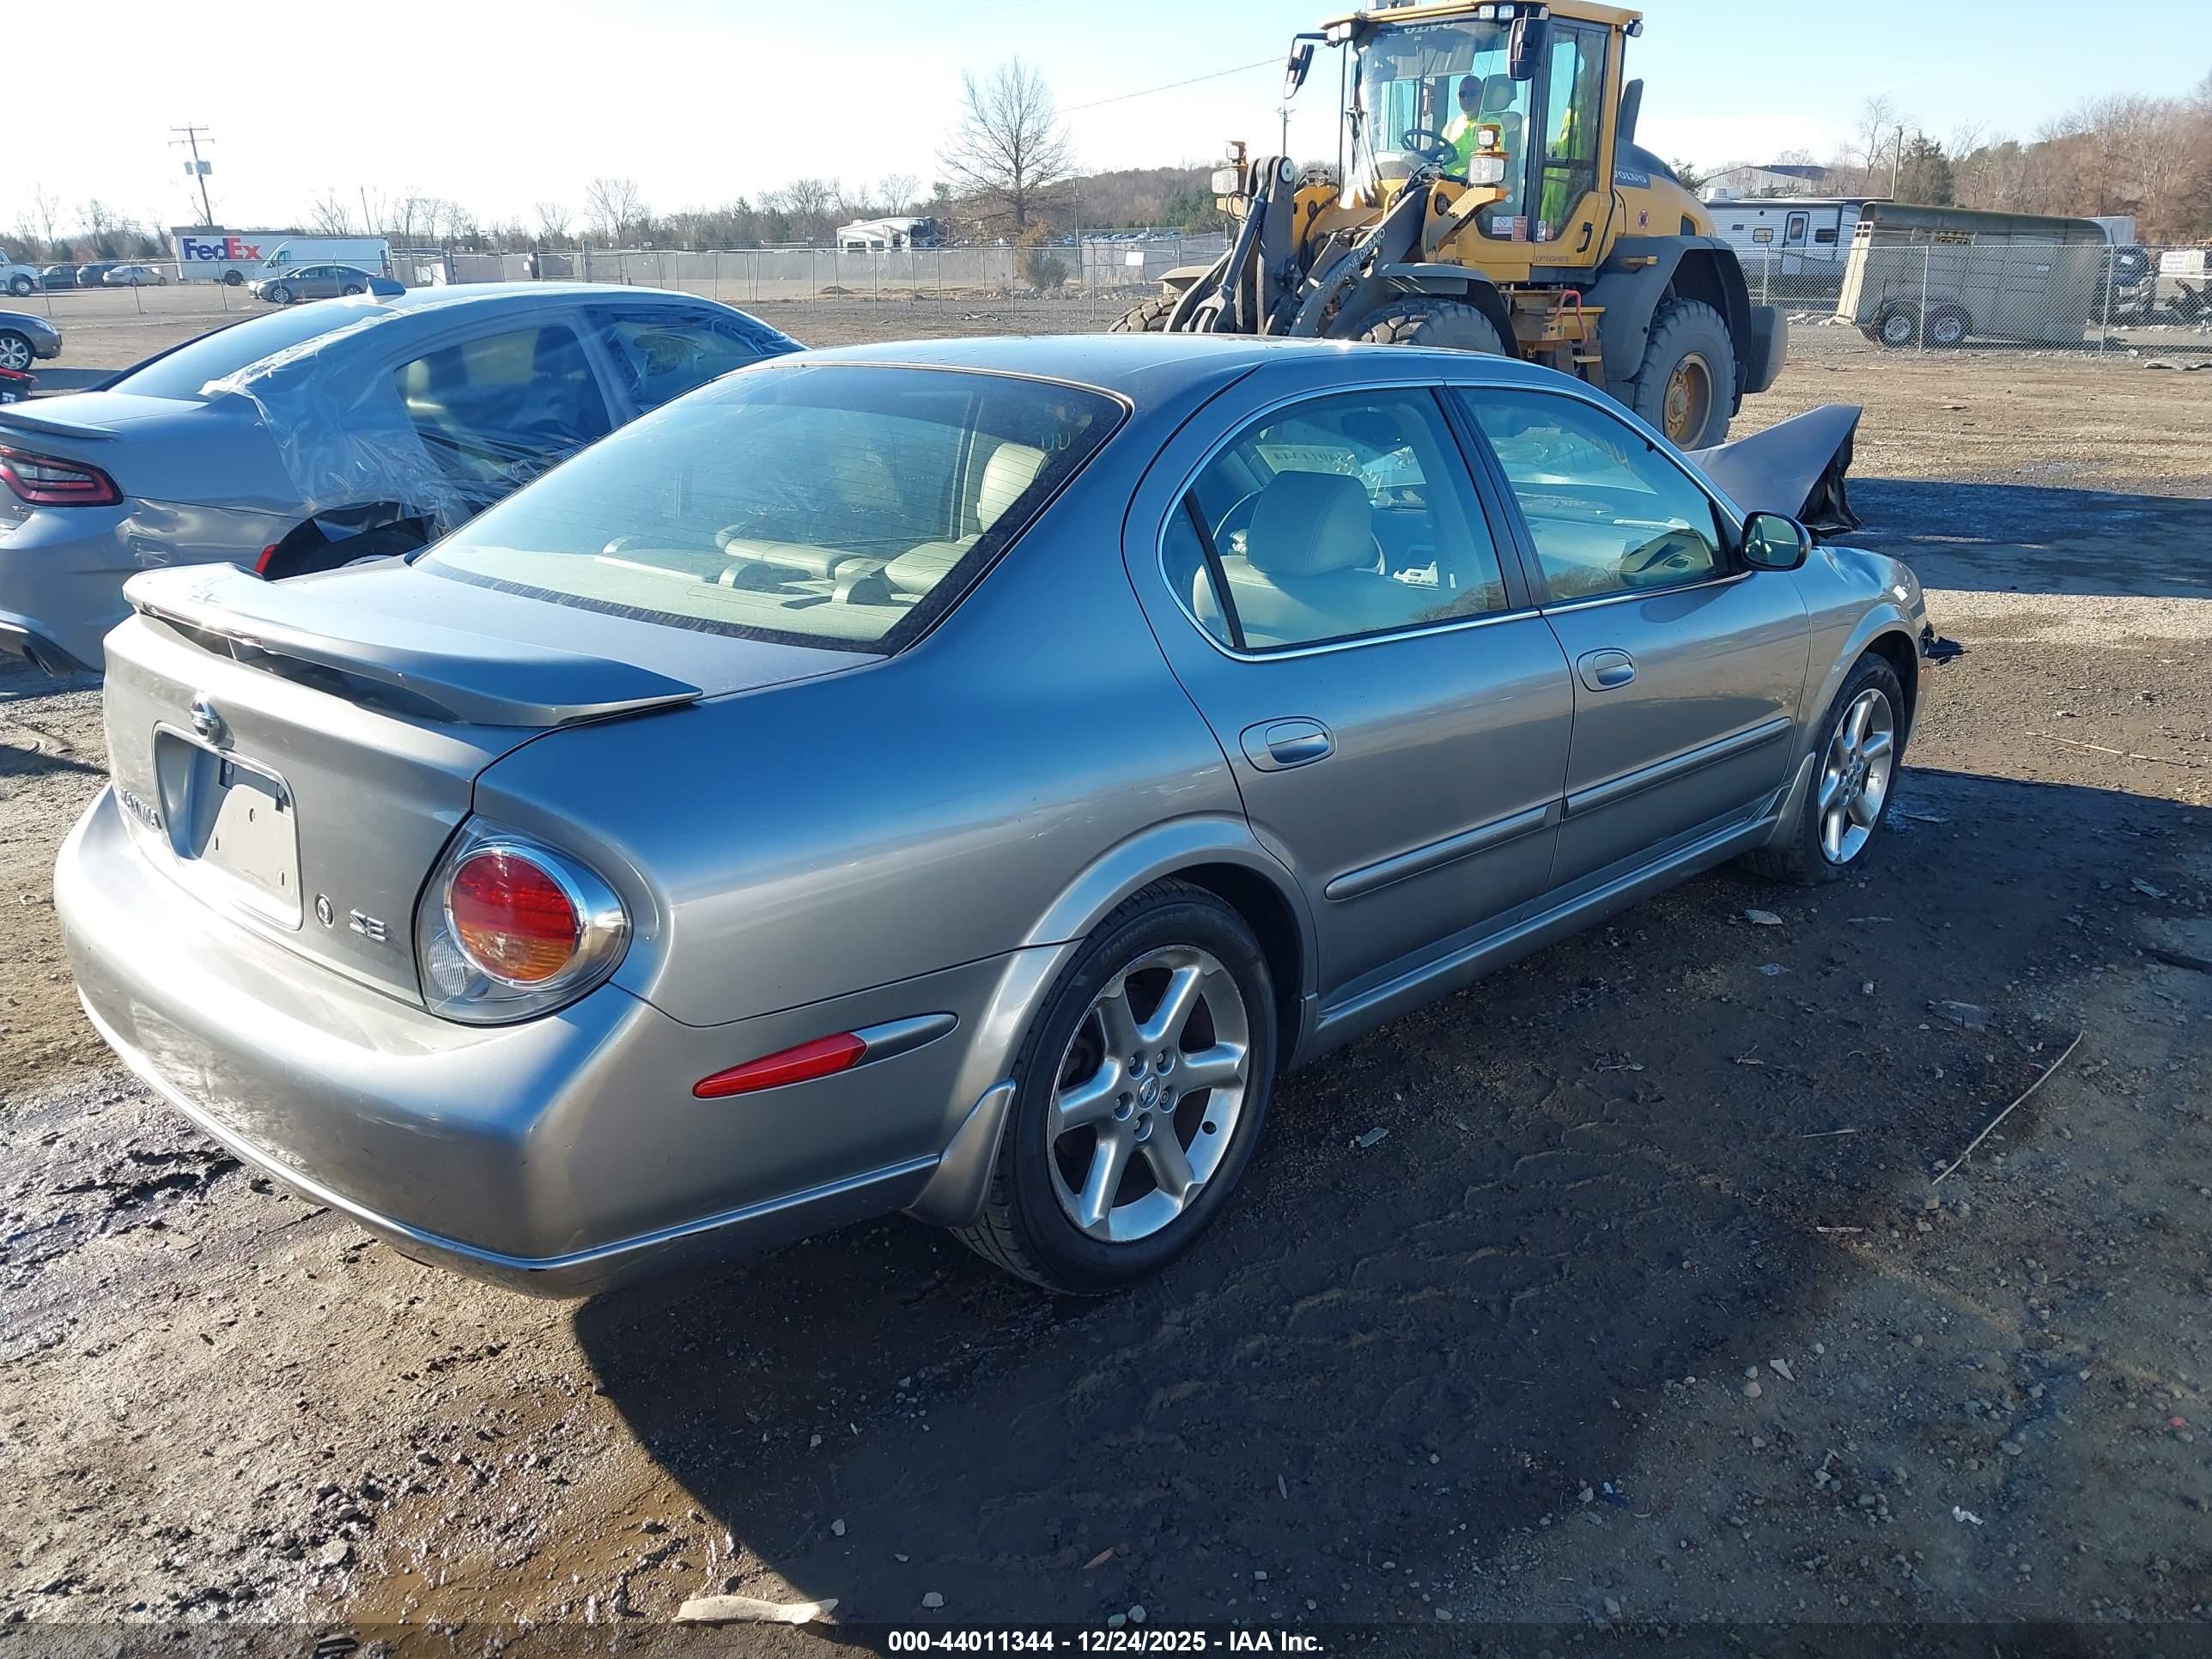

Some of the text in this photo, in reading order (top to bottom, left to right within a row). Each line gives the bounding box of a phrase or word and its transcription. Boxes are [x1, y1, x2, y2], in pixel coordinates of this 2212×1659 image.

[182, 238, 263, 261] FedEx
[1331, 255, 1359, 287] CAMINE
[1358, 228, 1386, 260] DEBAJO
[349, 907, 385, 943] SE
